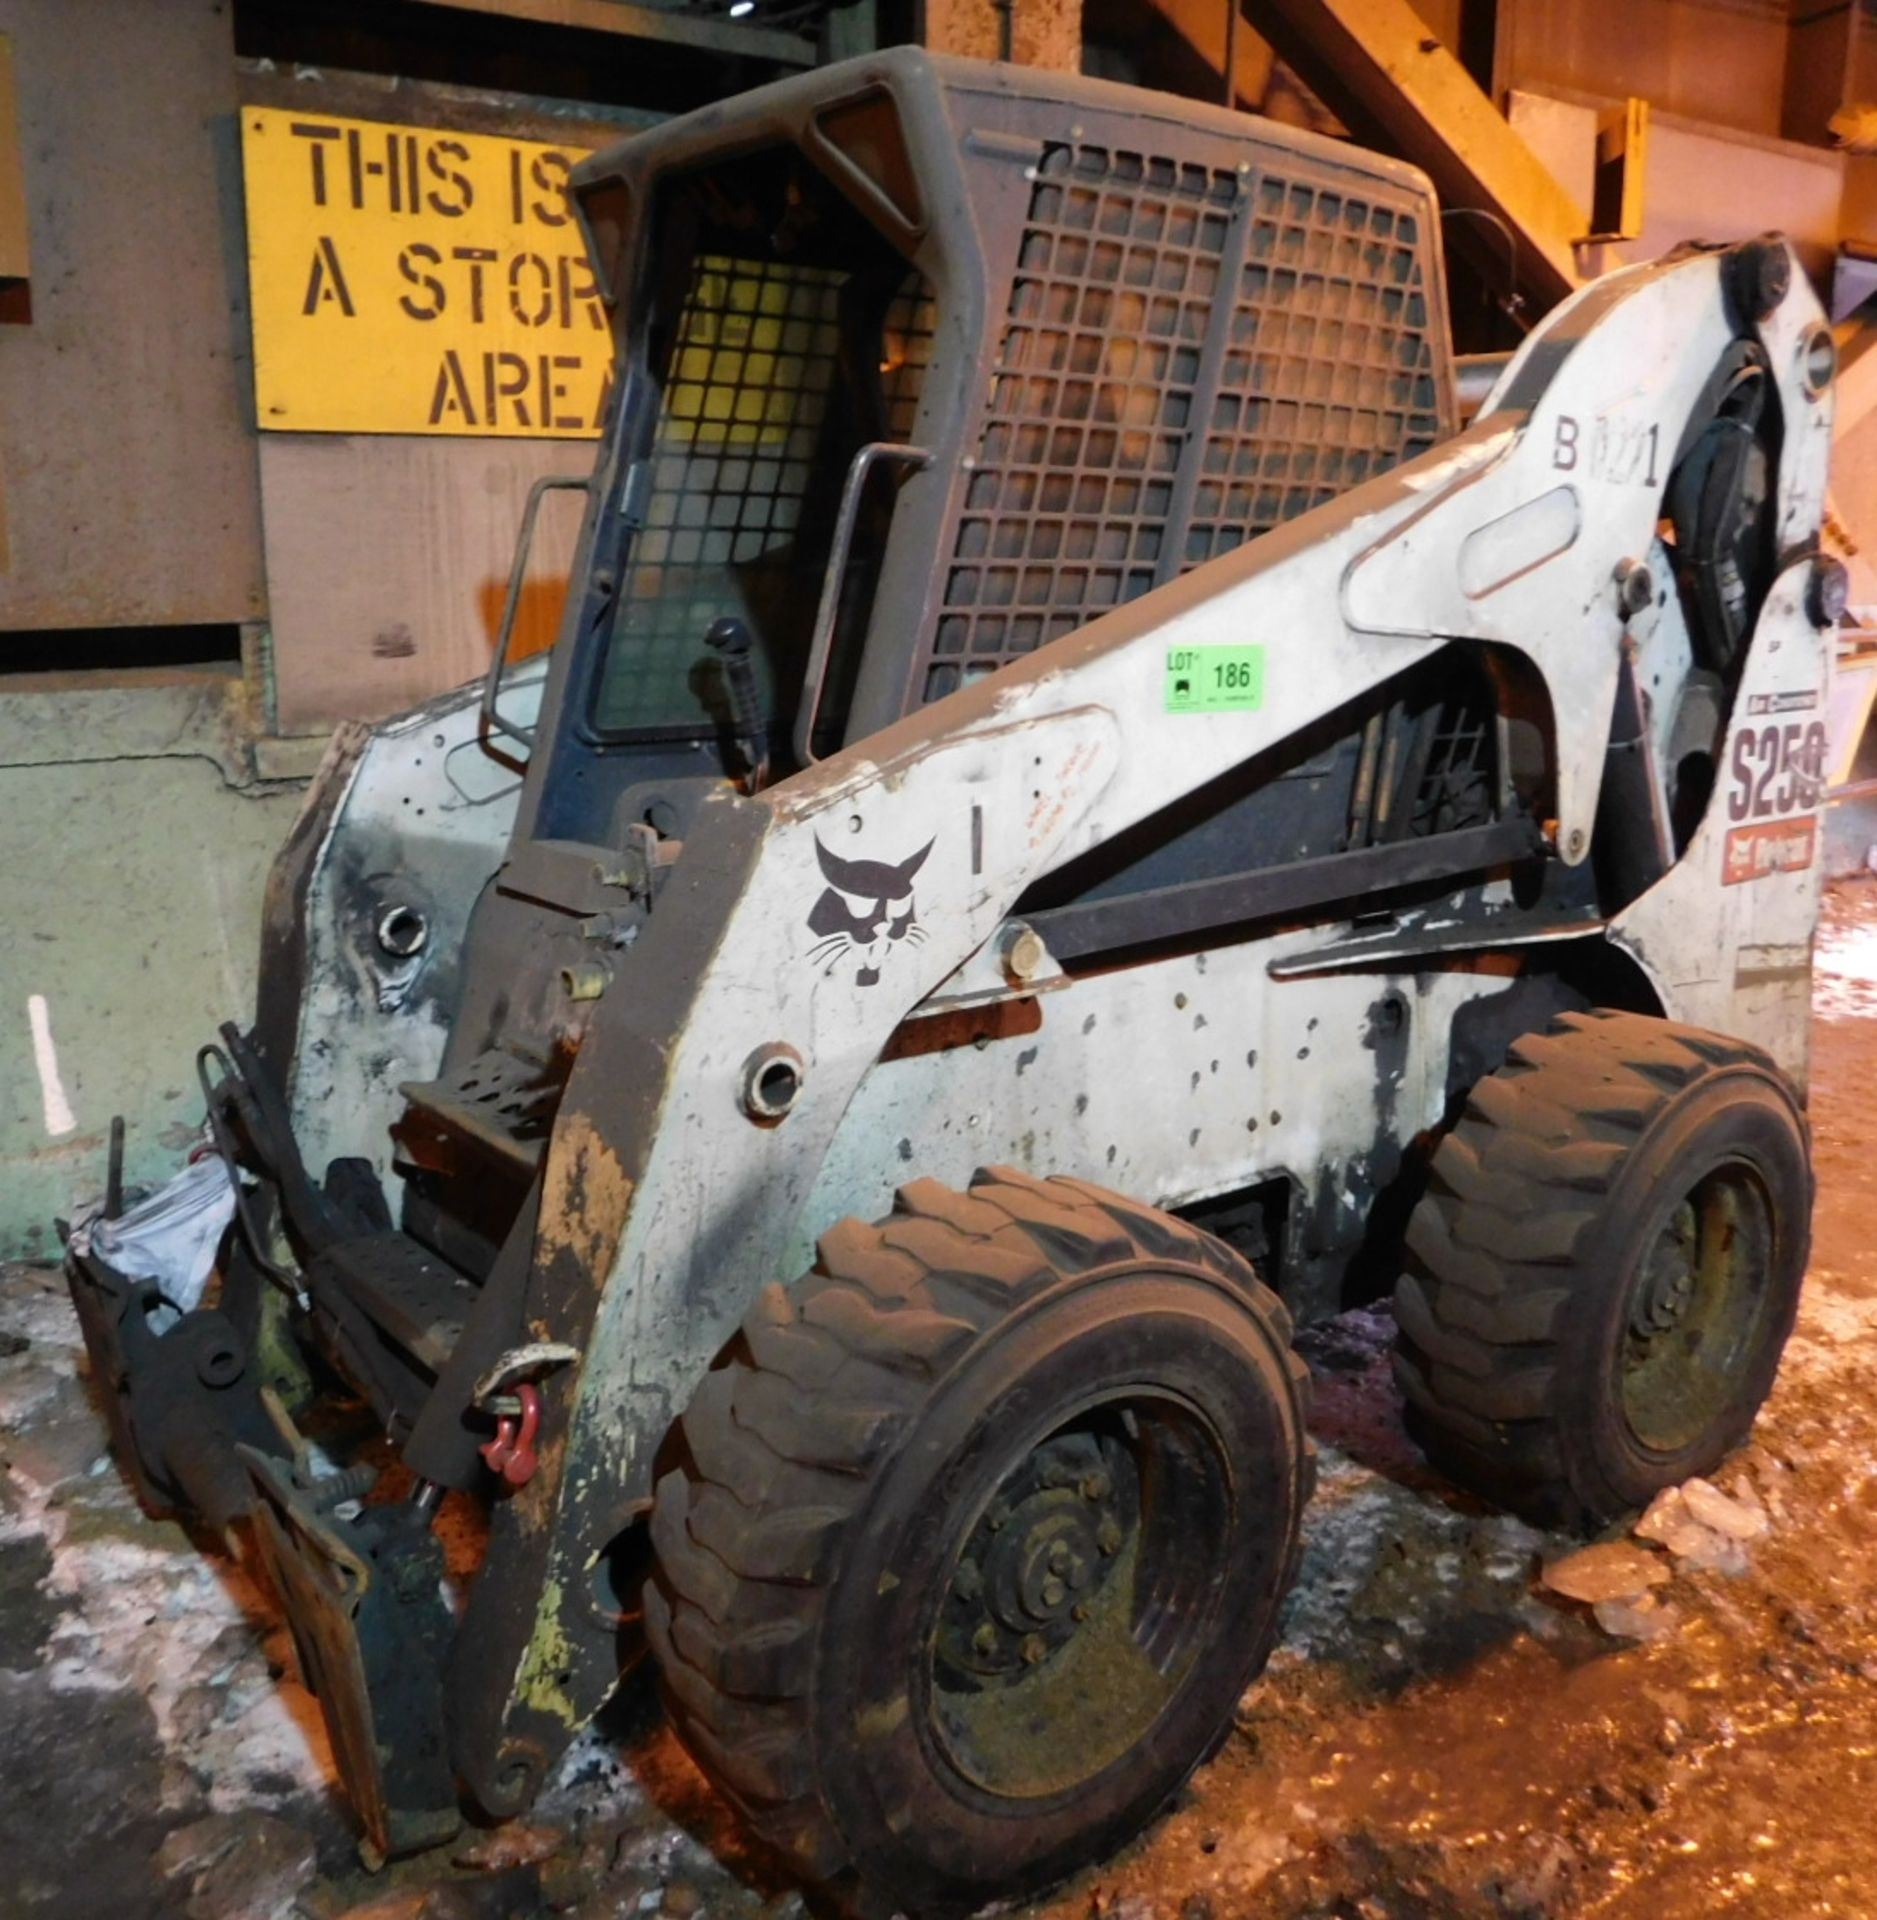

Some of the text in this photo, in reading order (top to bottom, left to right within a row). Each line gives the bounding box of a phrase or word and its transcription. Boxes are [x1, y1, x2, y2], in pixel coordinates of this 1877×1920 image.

[291, 122, 576, 227] THIS IS
[302, 236, 356, 317] A
[428, 349, 614, 430] ARE
[1213, 661, 1250, 688] 186
[1728, 720, 1827, 822] S250
